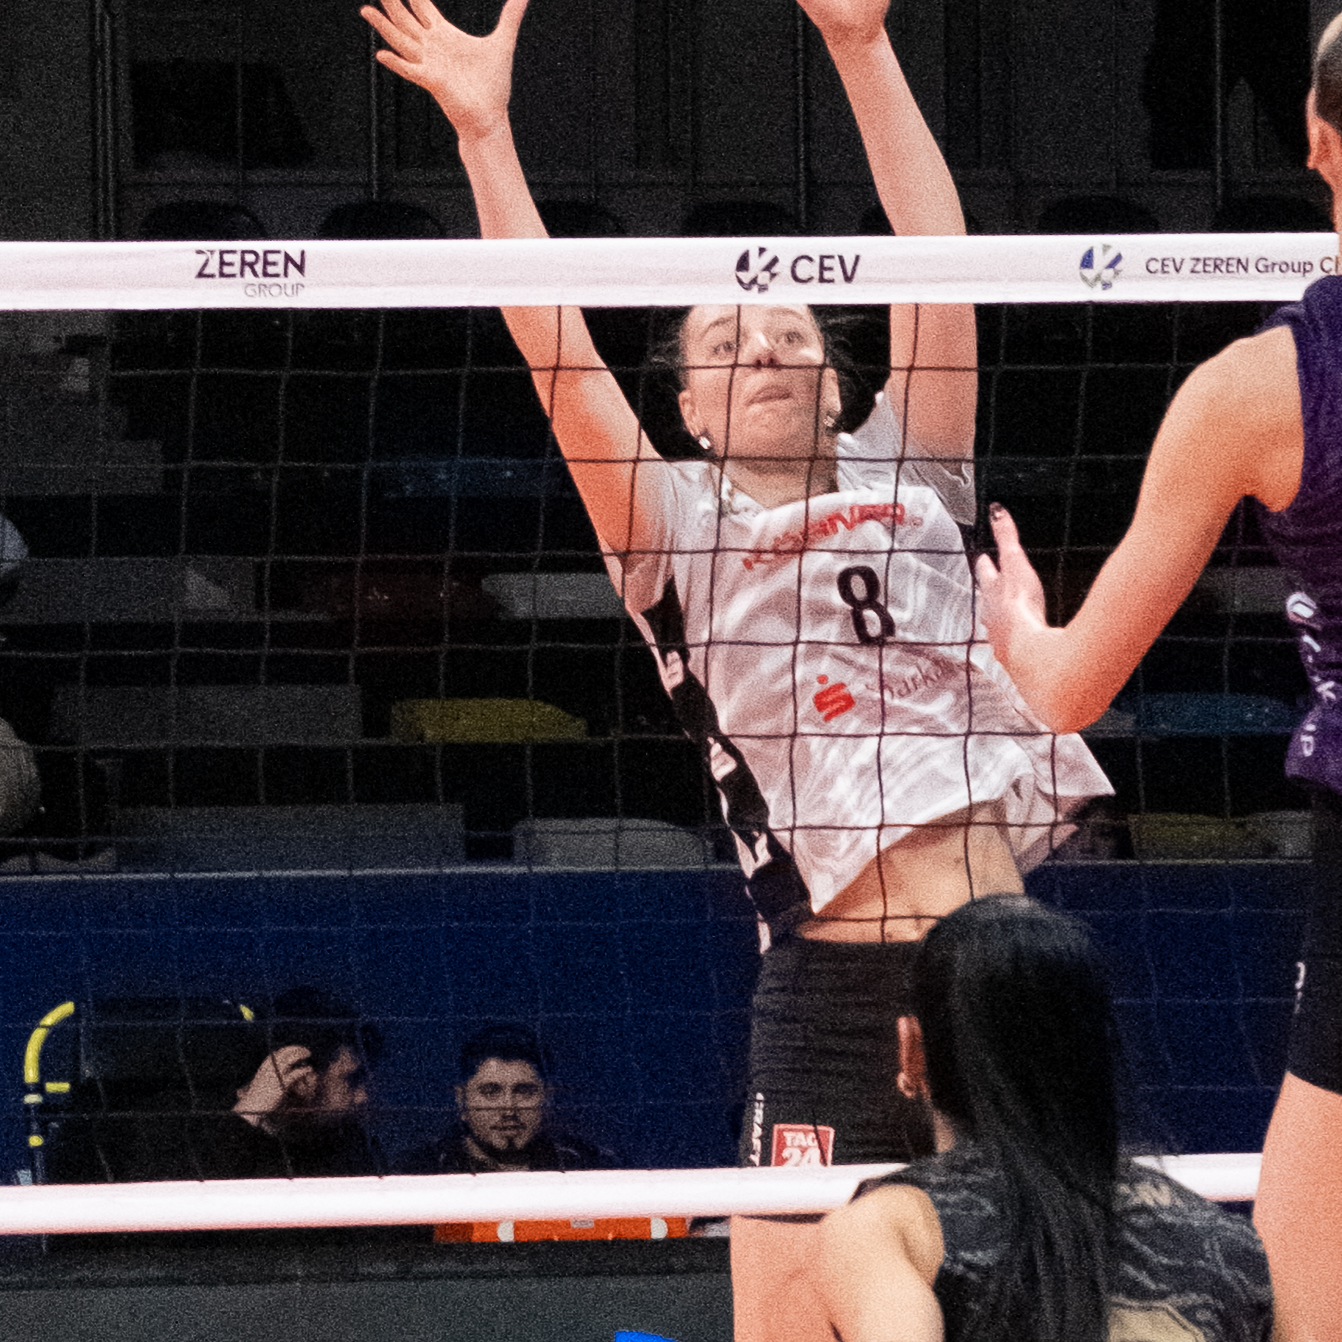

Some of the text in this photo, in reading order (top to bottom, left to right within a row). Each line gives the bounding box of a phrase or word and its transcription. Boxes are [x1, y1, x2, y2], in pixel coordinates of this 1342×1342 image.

[194, 248, 306, 279] ZEREN
[790, 254, 861, 284] CEV
[1145, 257, 1184, 274] CEV
[1190, 257, 1249, 274] ZEREN
[1254, 257, 1314, 278] Group
[243, 282, 306, 299] GROUP
[837, 566, 896, 645] 8
